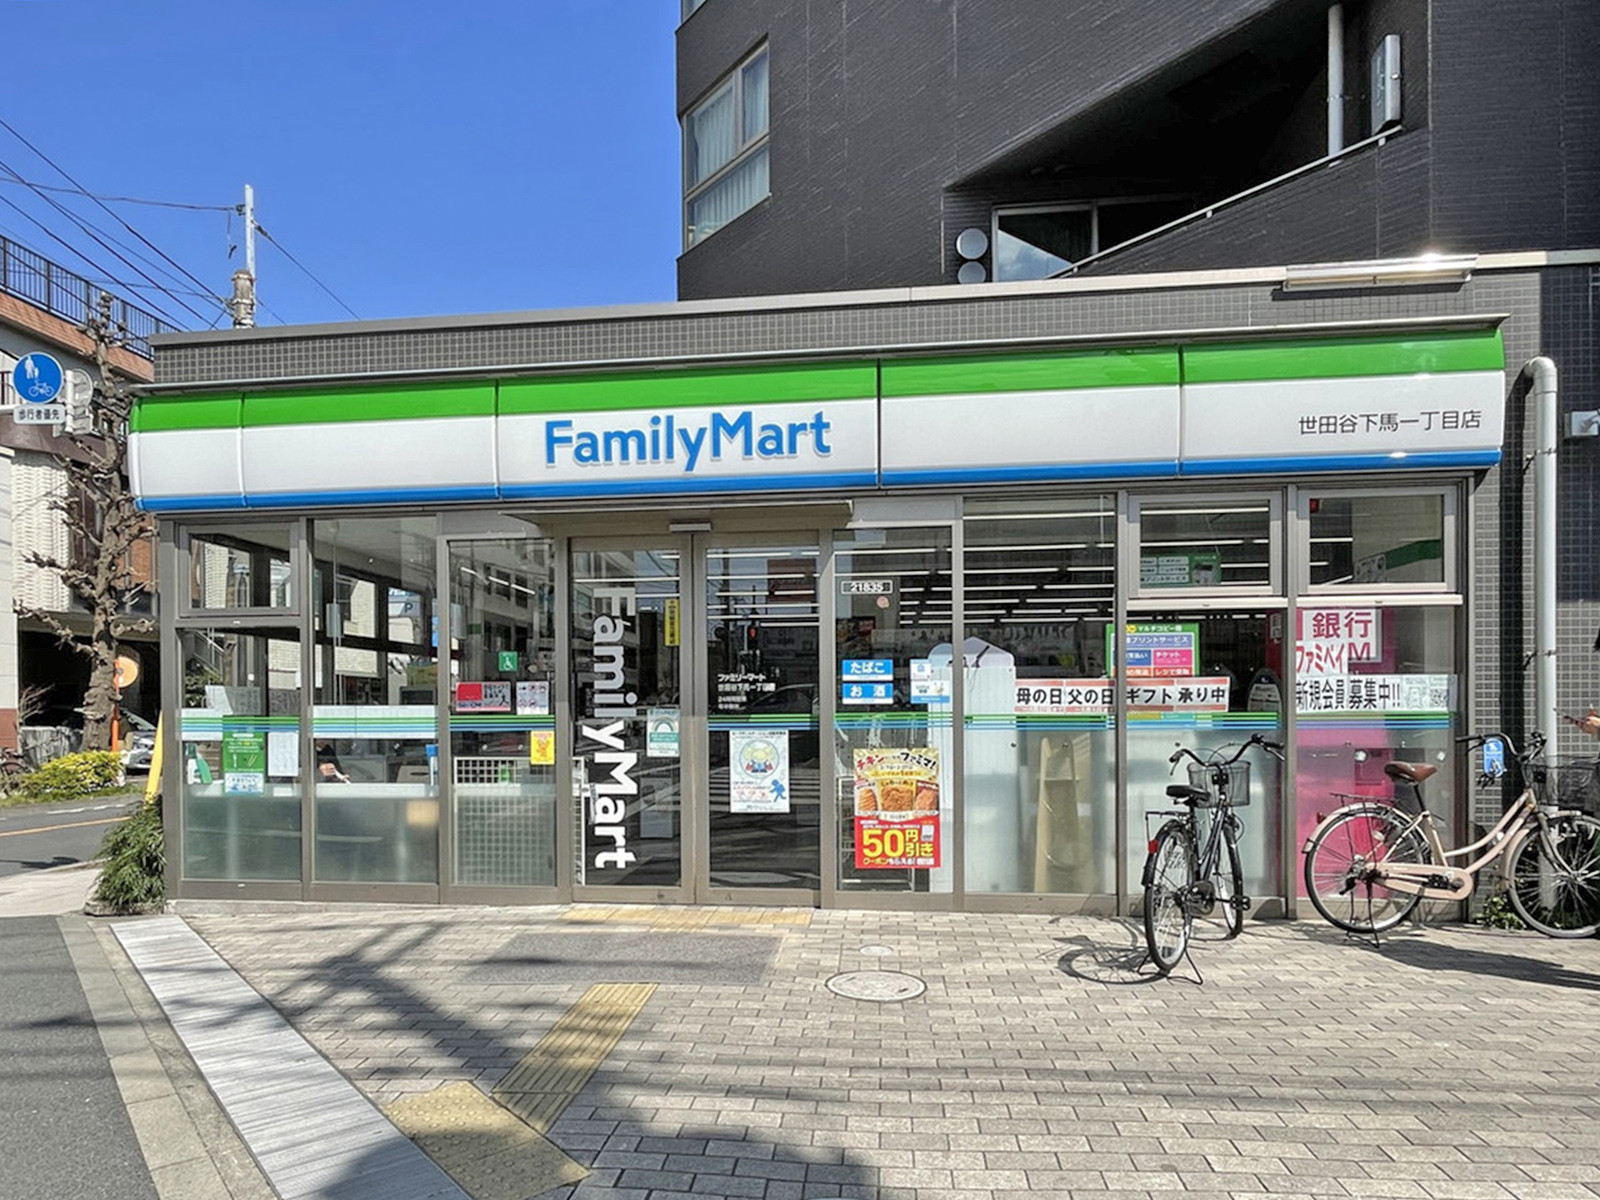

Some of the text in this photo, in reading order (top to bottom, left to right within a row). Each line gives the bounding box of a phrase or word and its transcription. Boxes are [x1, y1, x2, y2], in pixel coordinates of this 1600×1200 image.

[1299, 410, 1482, 435] 世田谷下馬一丁目店
[545, 410, 831, 472] FamilyMart
[1312, 611, 1373, 639] 銀行
[850, 661, 885, 674] たばこ
[1296, 643, 1345, 674] ファミペイ
[582, 587, 637, 869] FamilyMart
